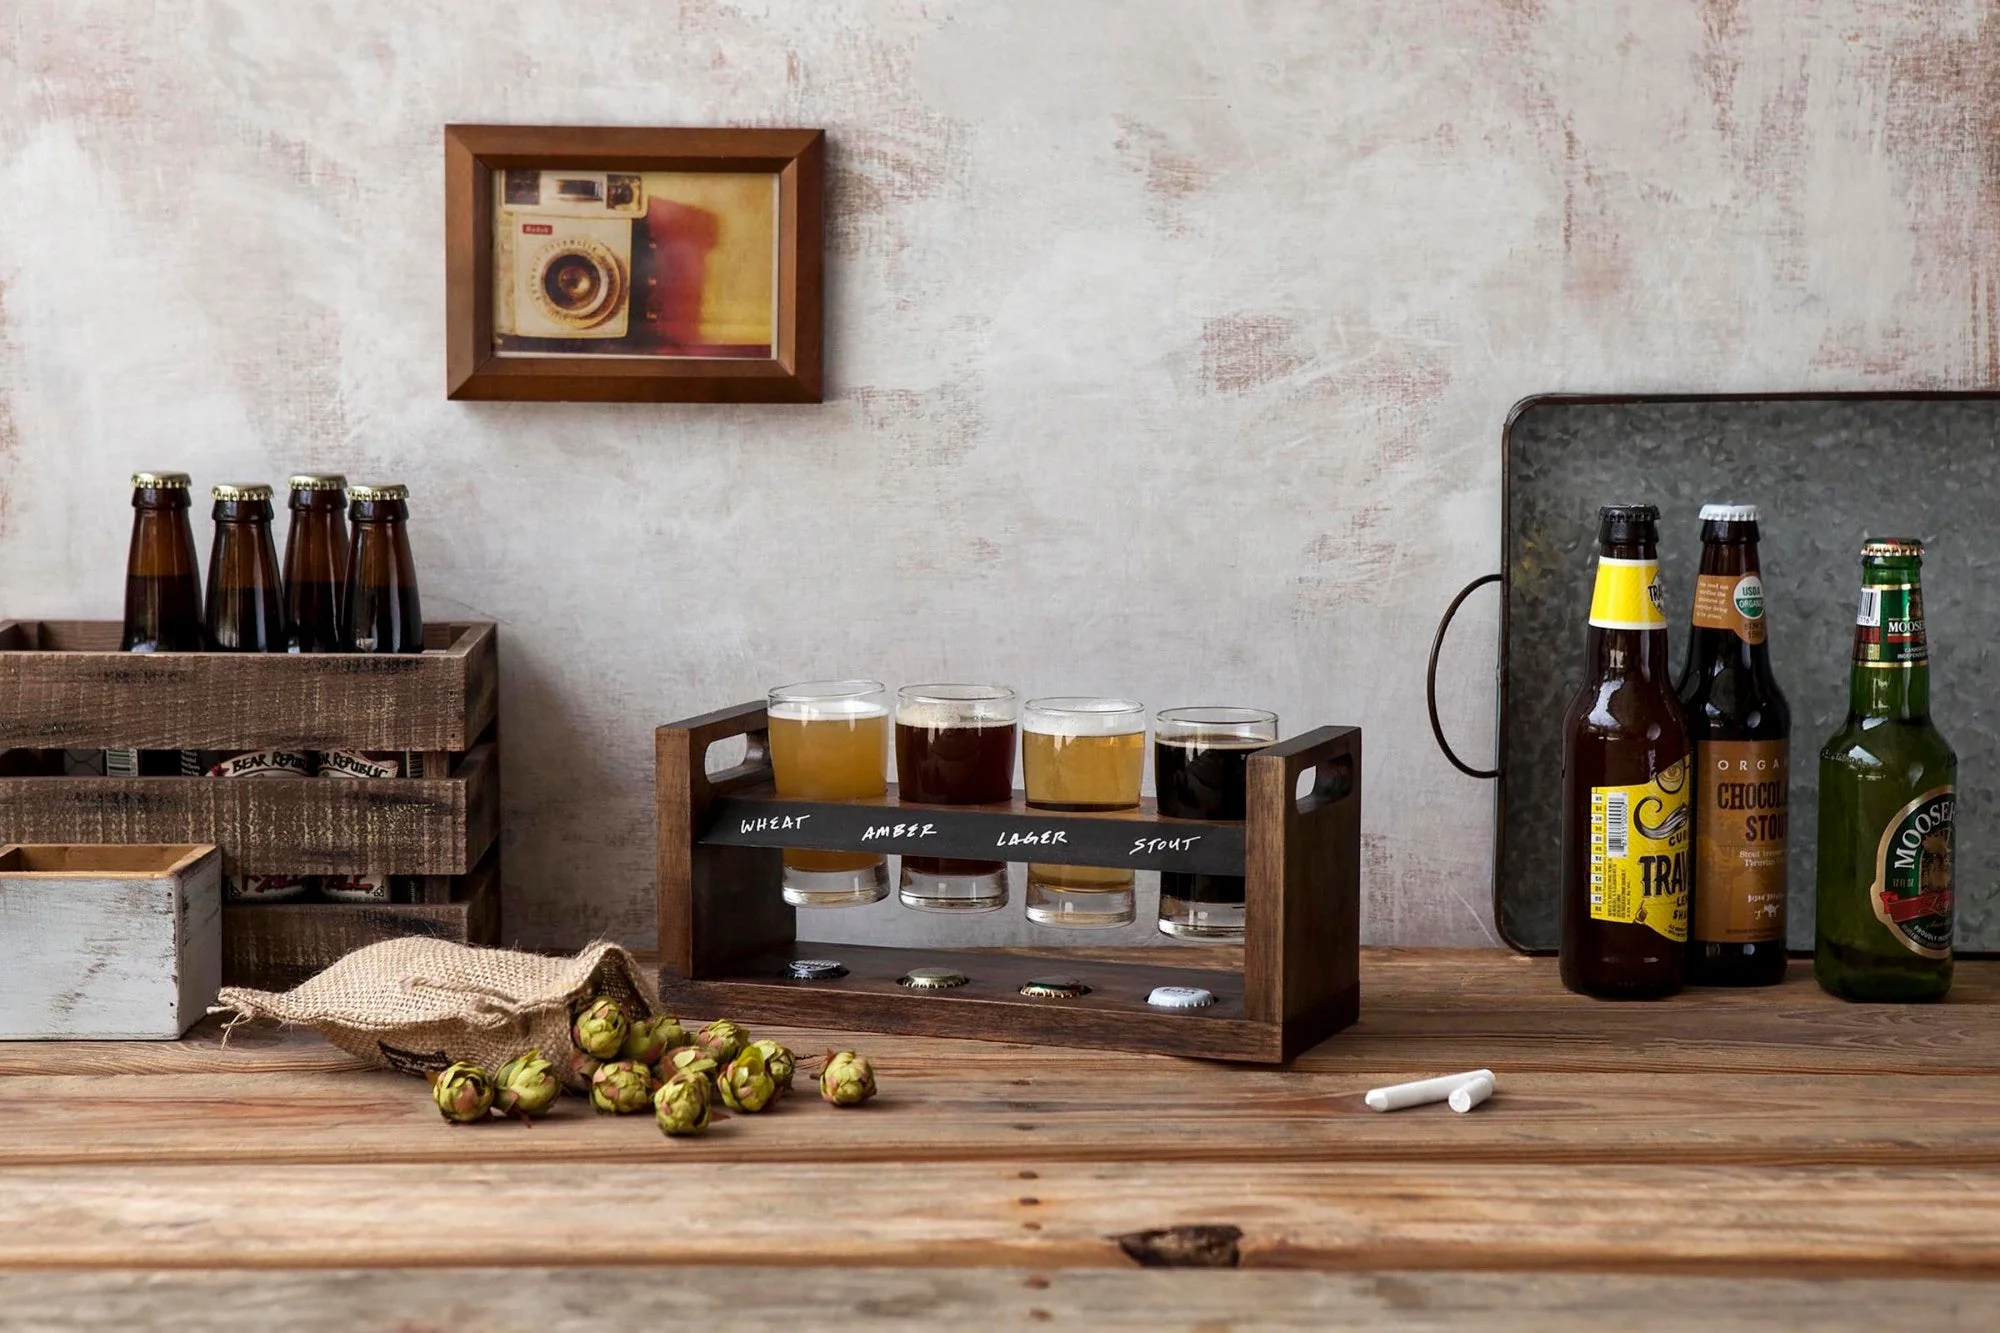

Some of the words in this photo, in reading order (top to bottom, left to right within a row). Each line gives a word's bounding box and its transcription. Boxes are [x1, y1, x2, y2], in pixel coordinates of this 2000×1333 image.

[1743, 587, 1761, 596] USDA
[232, 751, 271, 774] BEAR
[740, 814, 810, 835] WHEAT
[862, 822, 938, 841] AMBER
[997, 830, 1069, 848] LAGER
[1129, 835, 1201, 855] STOUT
